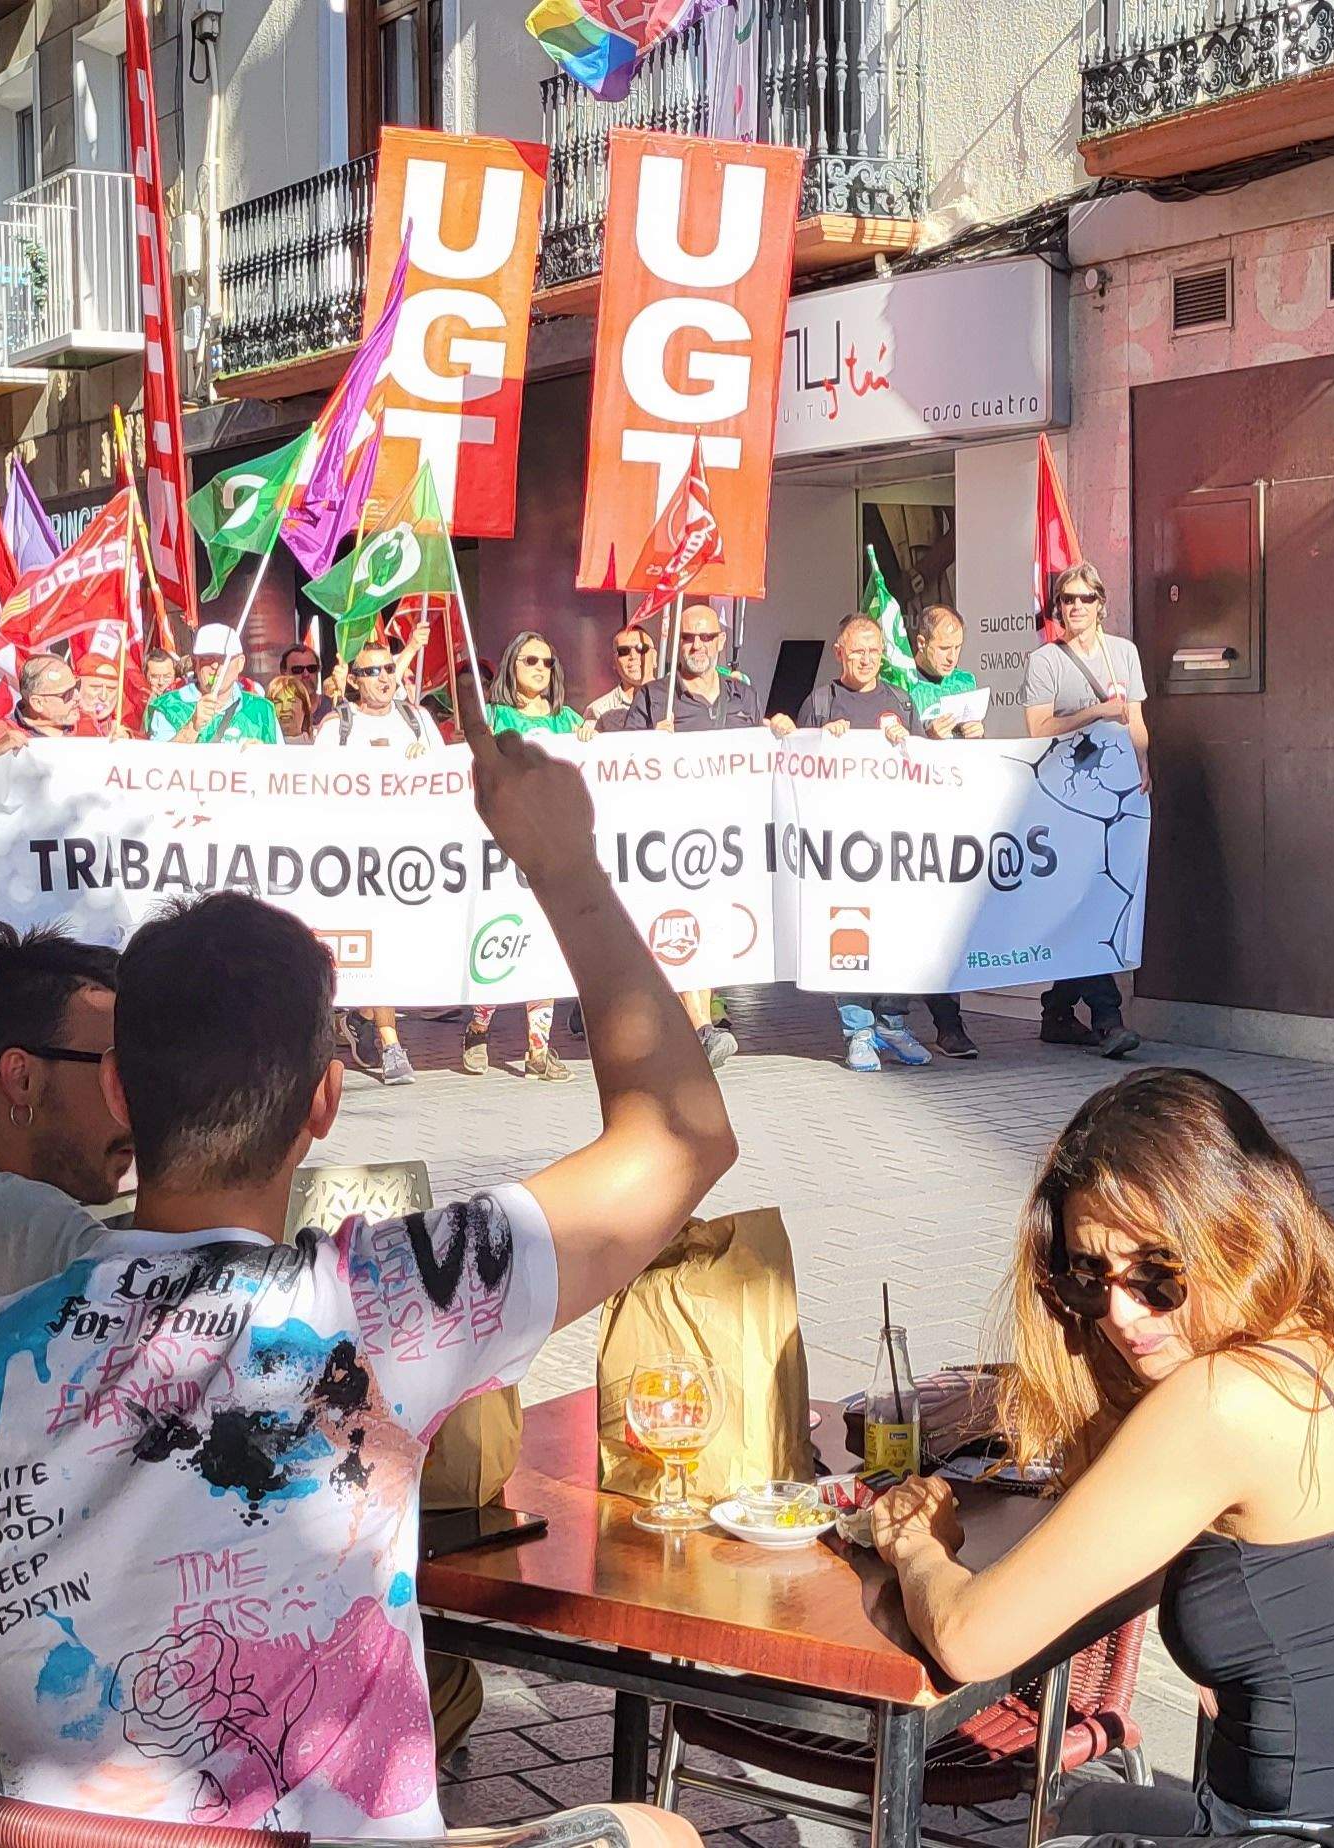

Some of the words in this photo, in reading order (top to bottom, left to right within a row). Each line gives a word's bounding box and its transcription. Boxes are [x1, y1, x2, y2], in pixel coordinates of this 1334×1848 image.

[377, 158, 524, 523] UGT
[621, 154, 767, 525] UGT
[923, 403, 961, 423] coso
[971, 394, 1038, 417] cuatro
[980, 612, 1035, 634] swatch
[105, 765, 256, 798] ALCALDE,
[269, 771, 371, 797] MENOS
[380, 769, 473, 798] EXPEDI
[597, 752, 662, 783] MÁS
[673, 750, 784, 780] CUMPLIR
[787, 752, 963, 787] COMPROMISS
[29, 837, 467, 905] TRABAJADOR@S
[764, 821, 1059, 892] IGNORAD@S
[480, 934, 531, 960] CSIF
[830, 954, 870, 970] CGT
[966, 945, 1052, 970] #BastaYa
[153, 1547, 268, 1603] TIME
